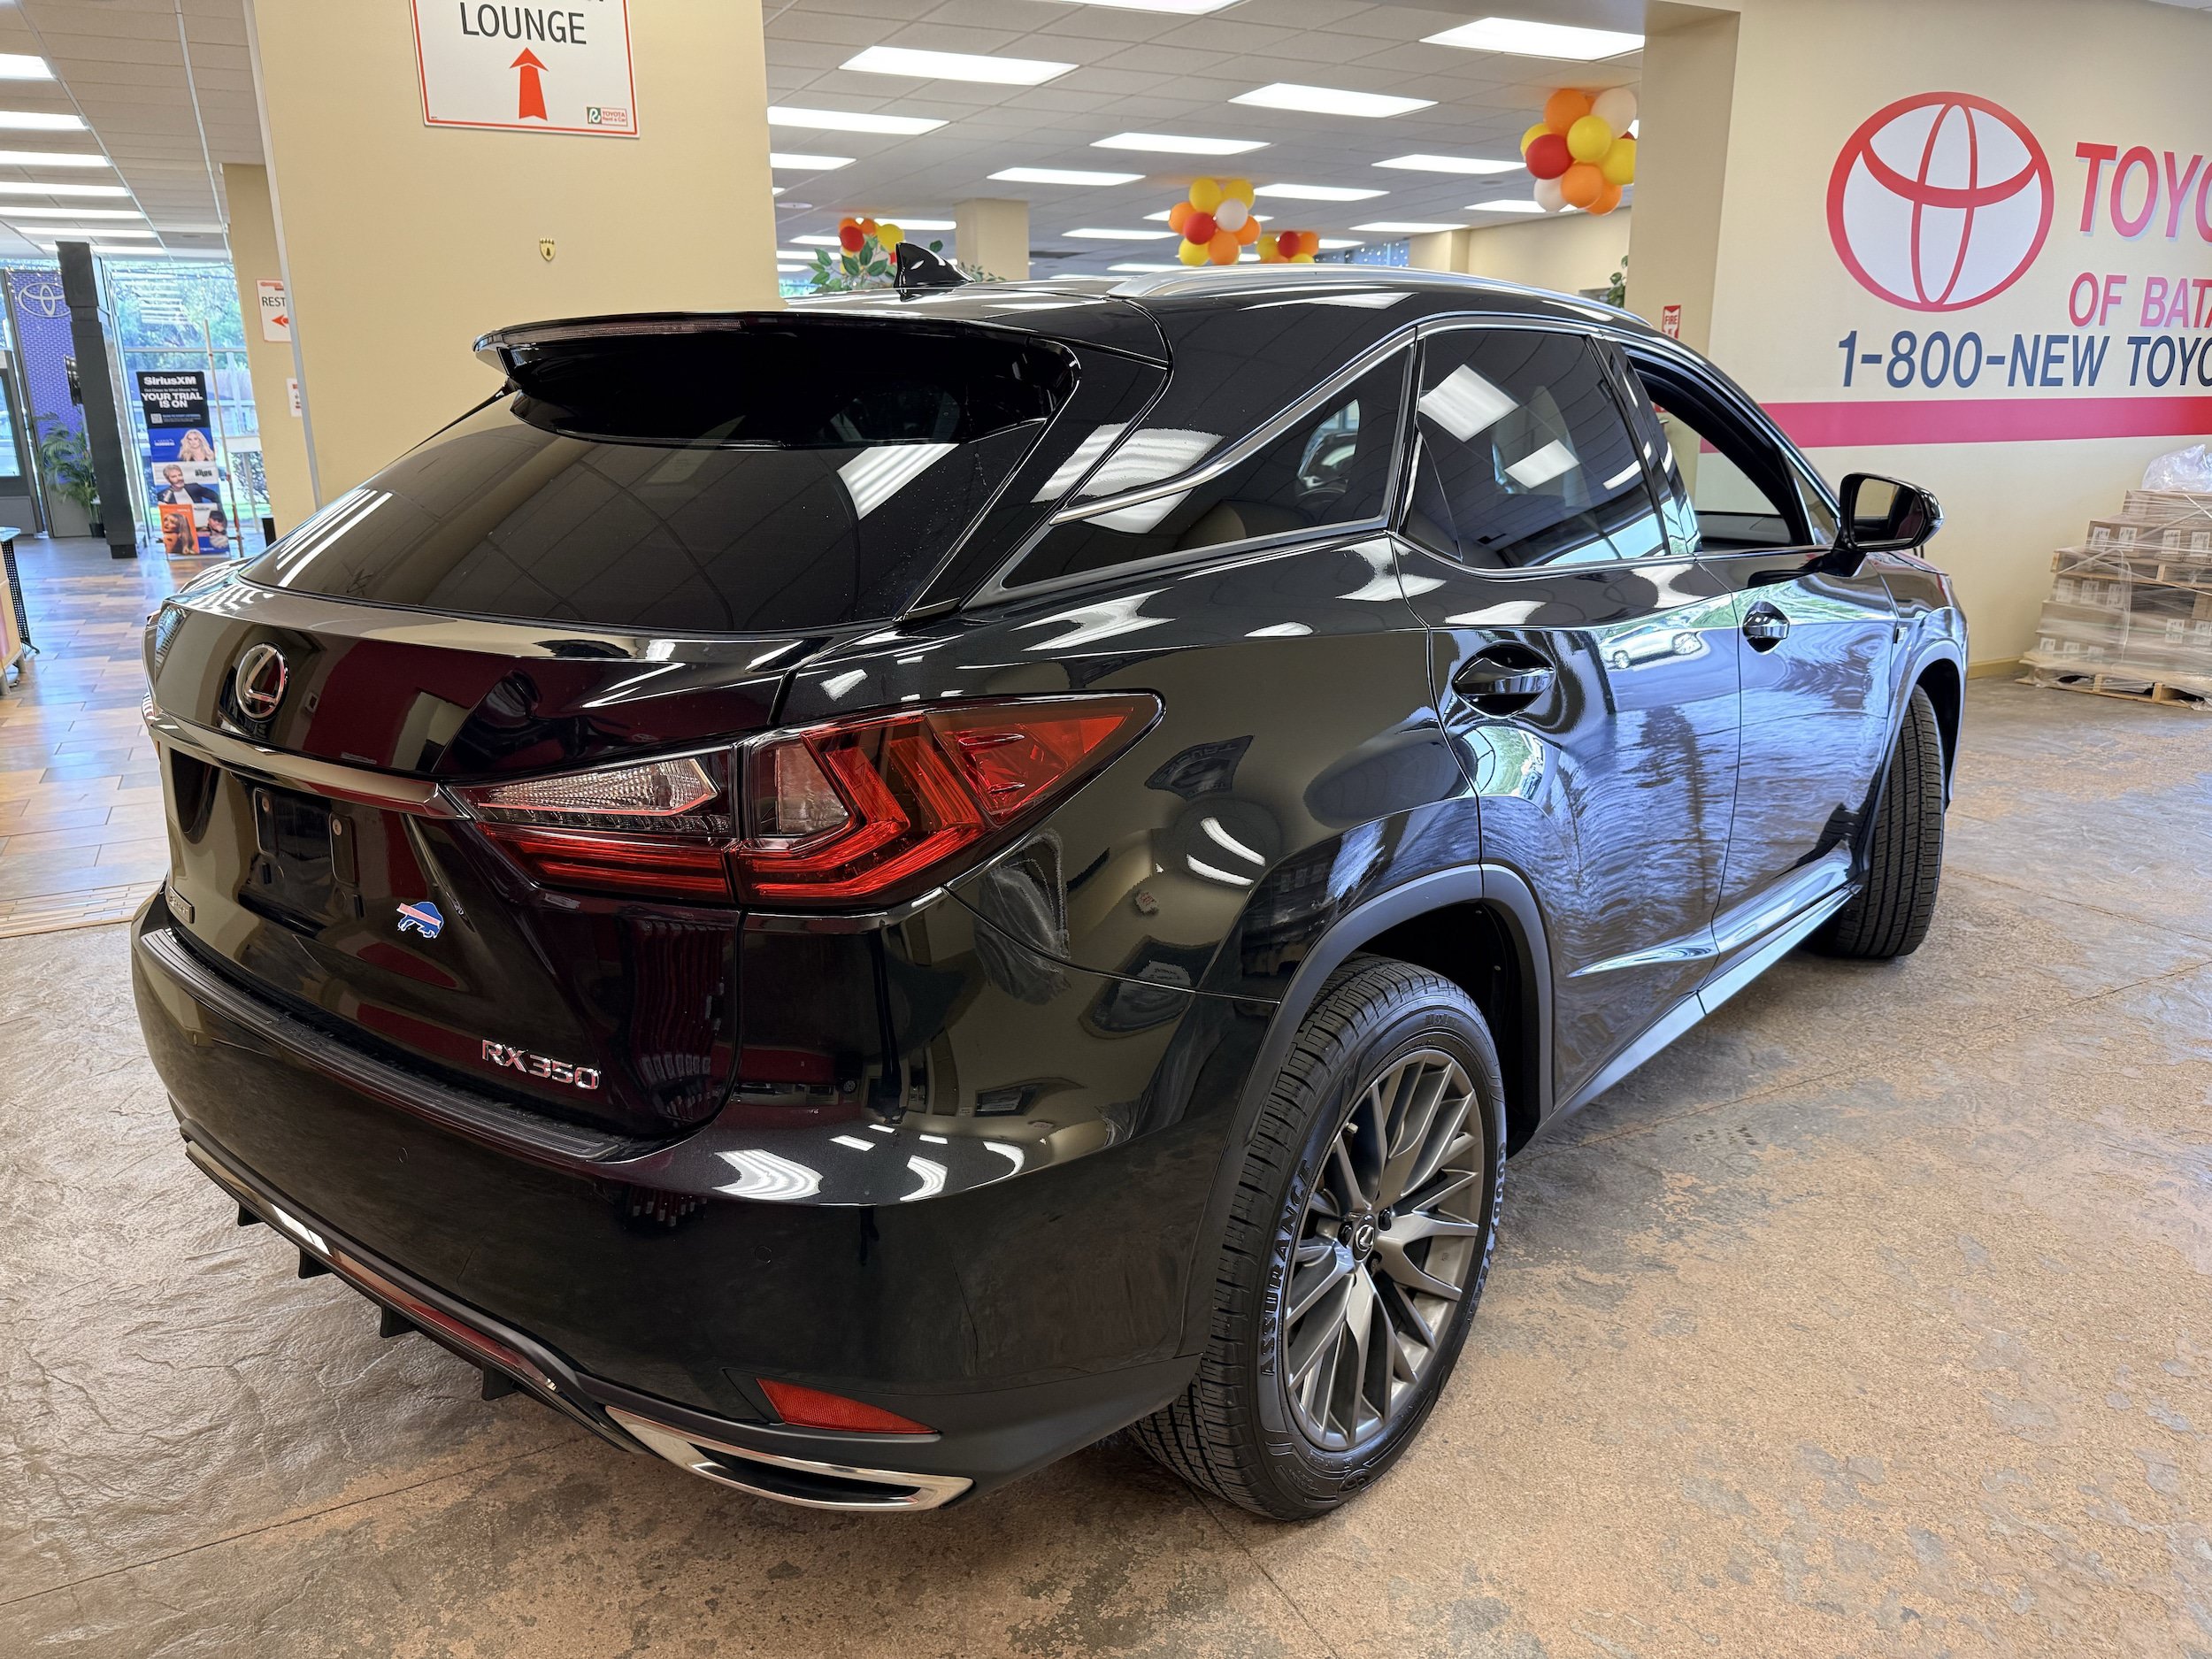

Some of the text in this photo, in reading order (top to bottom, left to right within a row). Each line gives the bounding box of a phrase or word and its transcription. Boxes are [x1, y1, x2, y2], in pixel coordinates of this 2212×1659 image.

[460, 2, 587, 45] LOUNGE
[261, 296, 286, 307] REST
[2069, 272, 2212, 328] OF BAT
[1664, 315, 1678, 325] FIRE
[1838, 330, 2111, 388] 1-800-NEW
[143, 375, 197, 386] SiriusXM
[142, 392, 204, 402] YOUR TRIAL
[1260, 1159, 1312, 1377] ASSURANCE
